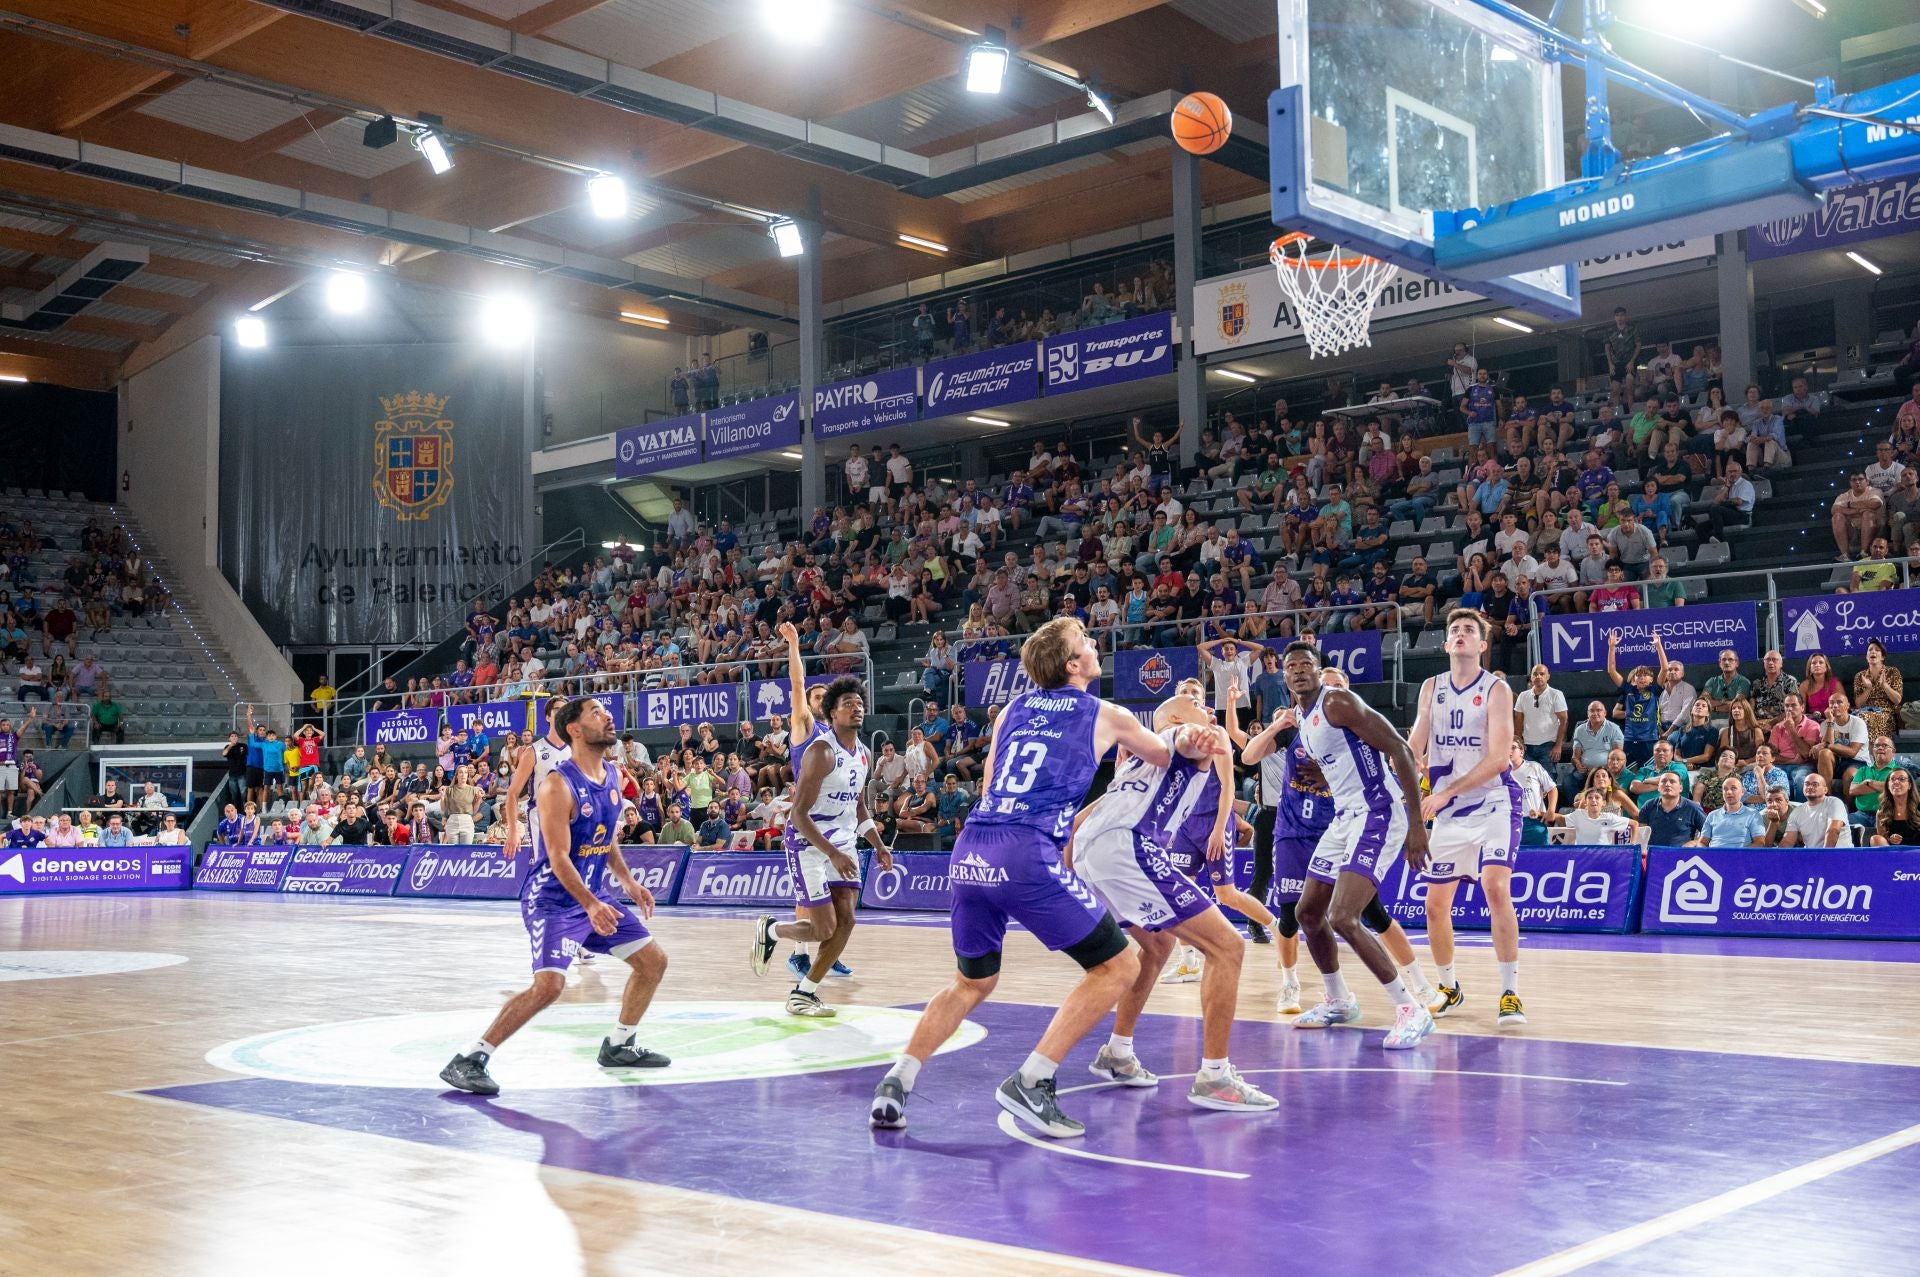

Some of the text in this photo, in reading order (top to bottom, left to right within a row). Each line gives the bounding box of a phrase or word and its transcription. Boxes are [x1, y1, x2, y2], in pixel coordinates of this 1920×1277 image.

[1560, 194, 1635, 226] MONDO
[1086, 329, 1164, 353] Transportes
[1083, 345, 1168, 374] BUJ
[950, 358, 1034, 387] NEUMÁTICOS
[944, 377, 1010, 401] PALENCIA
[710, 413, 746, 426] Interiorismo
[822, 410, 906, 433] Transporte de Vehículos
[638, 425, 696, 452] VAYMA
[710, 421, 771, 446] Villanova
[300, 540, 523, 573] Ayuntamiento
[1835, 600, 1875, 631] La
[1664, 638, 1691, 650] Dental
[1694, 638, 1734, 648] Inmediata
[1141, 669, 1169, 680] PALENCIA
[672, 691, 728, 720] PETKUS
[381, 718, 423, 728] DESGUACE
[1450, 709, 1463, 729] 10
[376, 725, 428, 742] MUNDO
[1436, 734, 1481, 746] UEMC
[995, 741, 1048, 793] 13
[1361, 744, 1378, 777] aspasia
[849, 769, 857, 787] 2
[1015, 802, 1029, 810] Dip
[1302, 798, 1313, 819] 8
[251, 852, 288, 865] FENDT
[437, 859, 516, 878] INMAPA
[1357, 854, 1374, 866] CBC
[196, 868, 242, 884] CASARES
[346, 863, 402, 879] MODOS
[584, 864, 595, 889] 2
[1174, 889, 1196, 906] CBC
[1734, 877, 1873, 911] épsilon
[1732, 912, 1776, 921] SOLUCIONES
[1778, 912, 1813, 921] TÉRMICAS
[1820, 912, 1870, 922] ENERGÉTICAS
